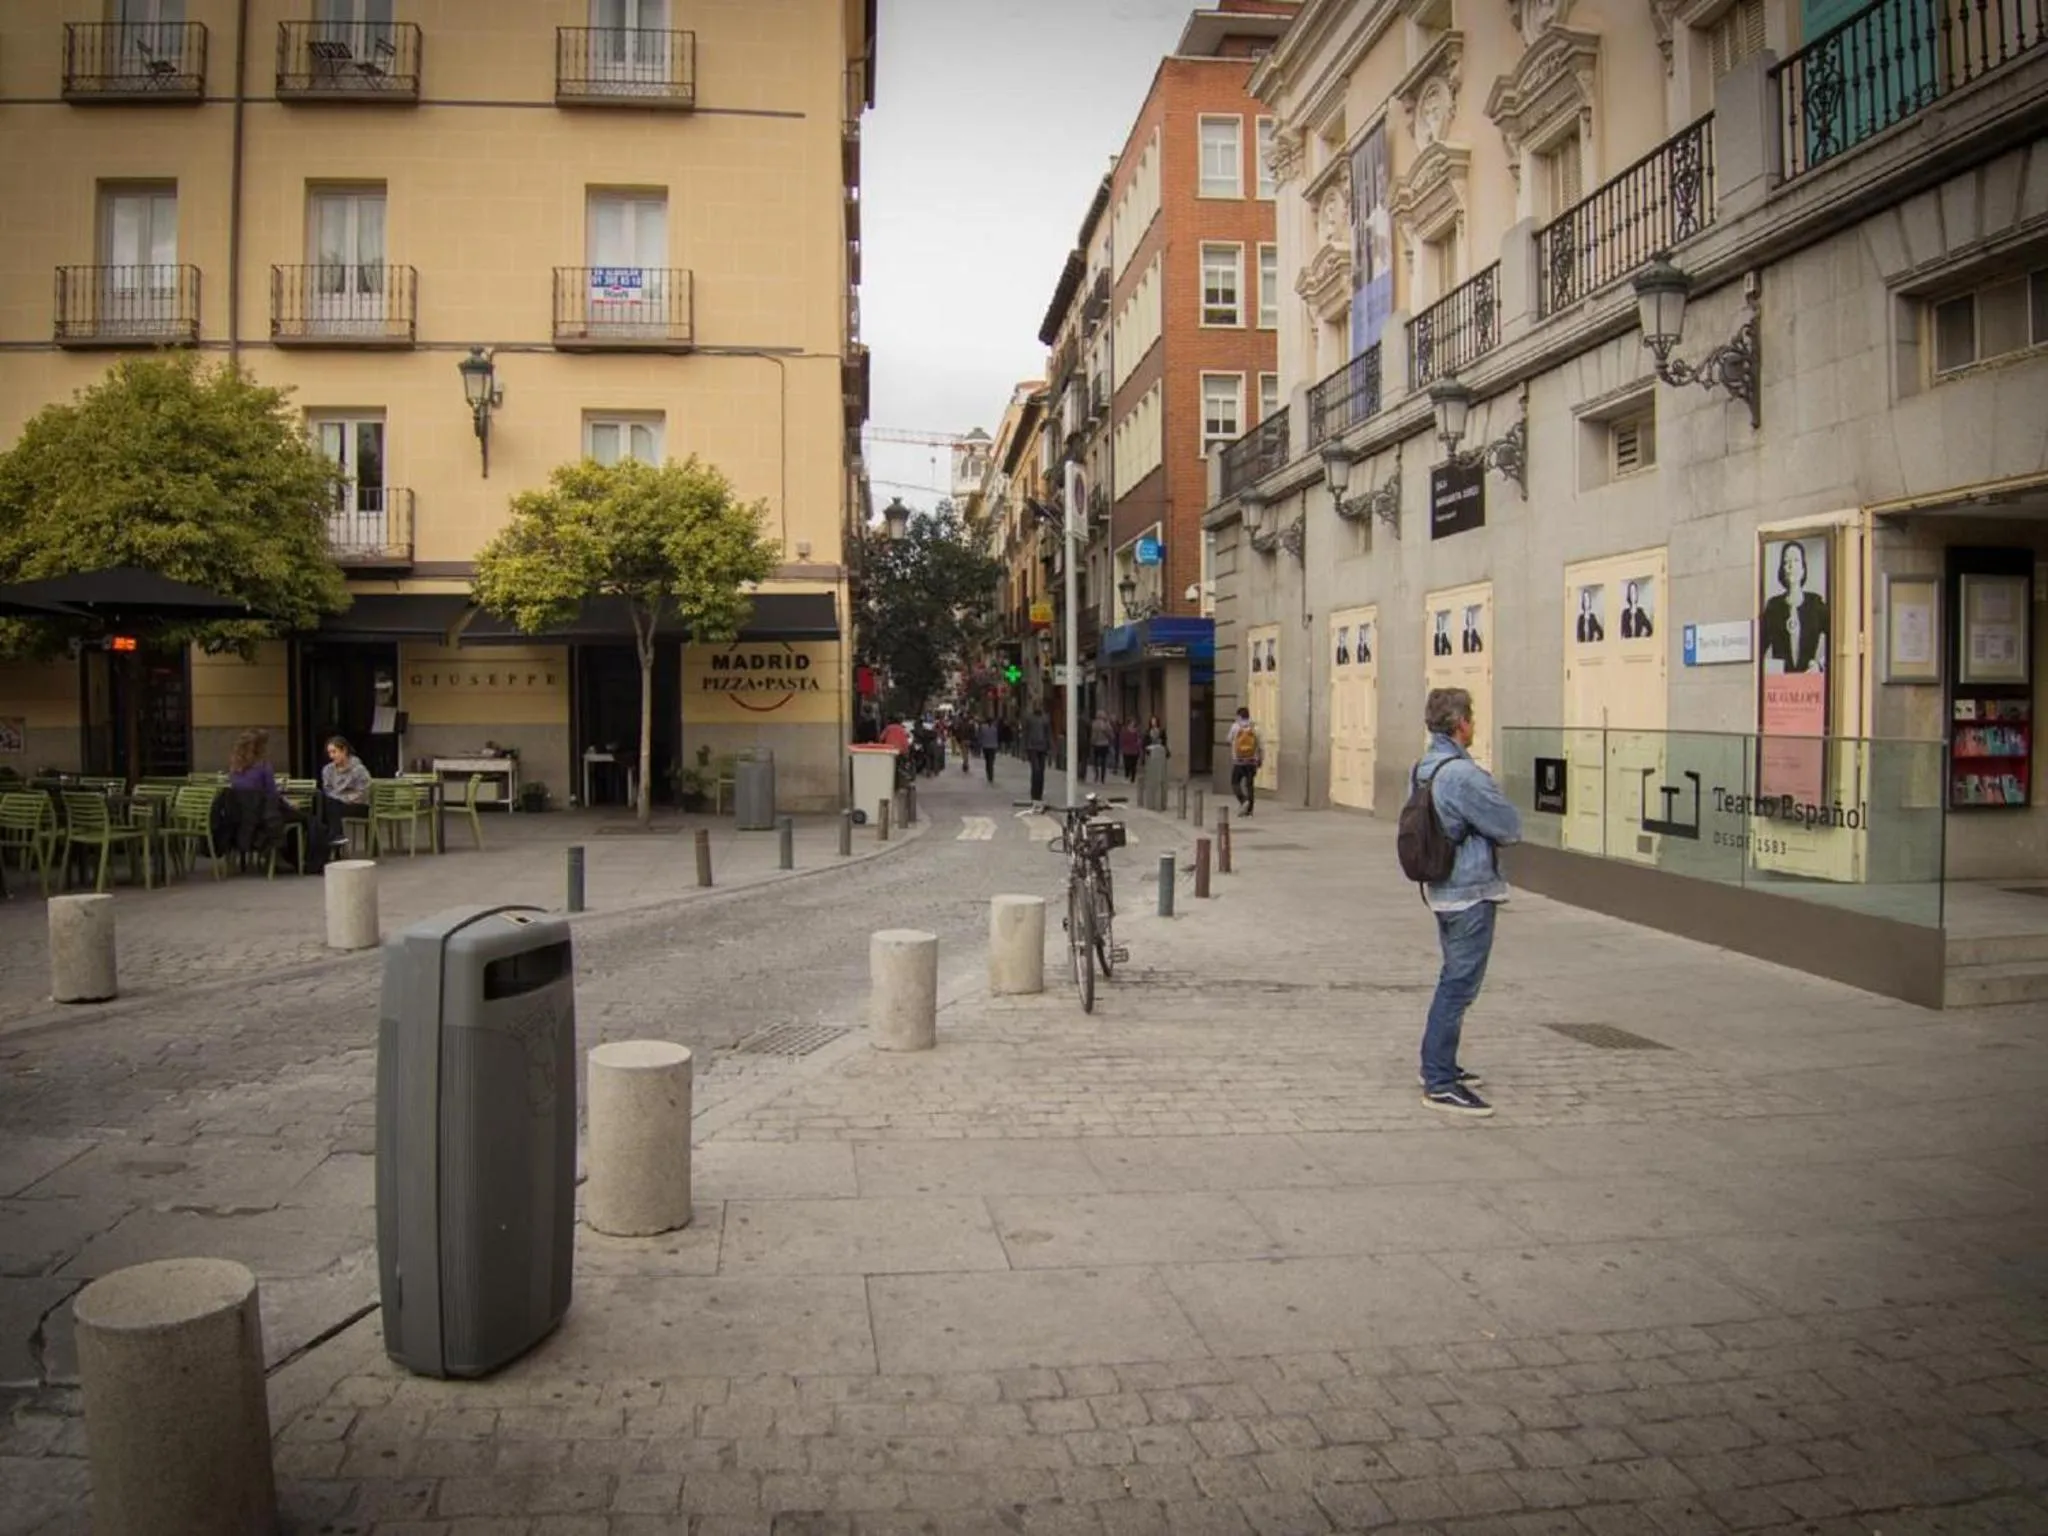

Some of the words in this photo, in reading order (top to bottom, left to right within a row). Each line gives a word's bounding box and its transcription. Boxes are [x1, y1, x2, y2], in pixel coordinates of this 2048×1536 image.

[712, 654, 811, 671] MADRID
[410, 673, 559, 688] GIUSEPPE
[1713, 785, 1777, 817] Teatro
[1780, 793, 1869, 831] Español
[1712, 830, 1752, 853] DESDE
[1756, 837, 1788, 856] 1583
